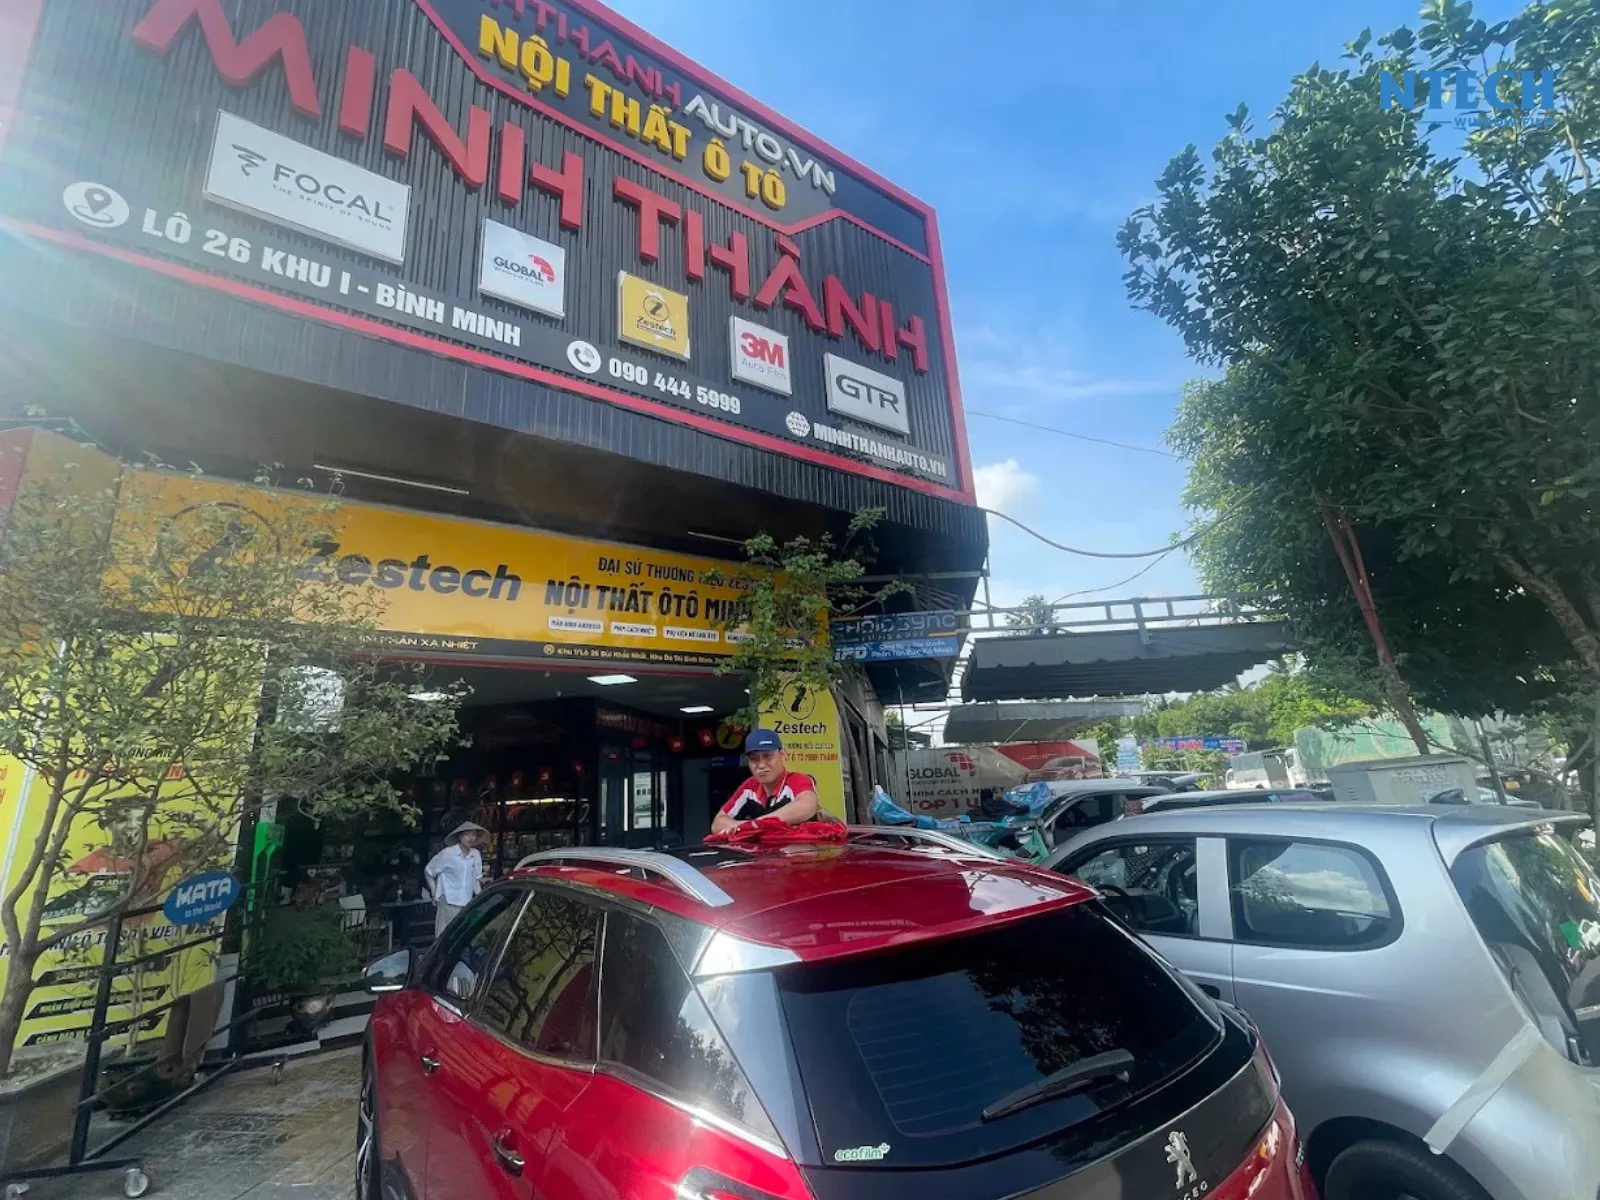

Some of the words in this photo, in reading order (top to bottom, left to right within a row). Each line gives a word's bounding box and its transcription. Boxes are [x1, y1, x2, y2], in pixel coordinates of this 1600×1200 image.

[479, 14, 571, 98] NỘI
[584, 73, 692, 161] THẤT
[703, 138, 731, 183] Ô
[741, 158, 787, 210] TÔ
[133, 0, 584, 229] MINH
[614, 175, 928, 372] THÀNH
[272, 163, 393, 223] FOCAL
[141, 207, 192, 244] LÔ
[202, 229, 251, 264] 26
[261, 246, 330, 289] KHU
[376, 280, 444, 325] BÌNH
[452, 306, 521, 347] MINH
[493, 256, 543, 282] GLOBAL
[741, 331, 785, 368] 3M
[608, 357, 648, 386] 090
[654, 372, 692, 400] 444
[696, 385, 741, 415] 5999
[835, 373, 900, 414] GTR
[813, 422, 947, 477] MINHTHANHAUTO.VN
[293, 539, 523, 602] Zestech
[597, 557, 620, 577] ĐẠI
[544, 575, 591, 615] NỘI
[596, 582, 654, 614] THẤT
[658, 586, 699, 618] ÔTÔ
[774, 720, 827, 735] Zestech
[906, 766, 961, 780] GLOBAL
[175, 877, 232, 908] KATA
[837, 1147, 883, 1159] ecofilm
